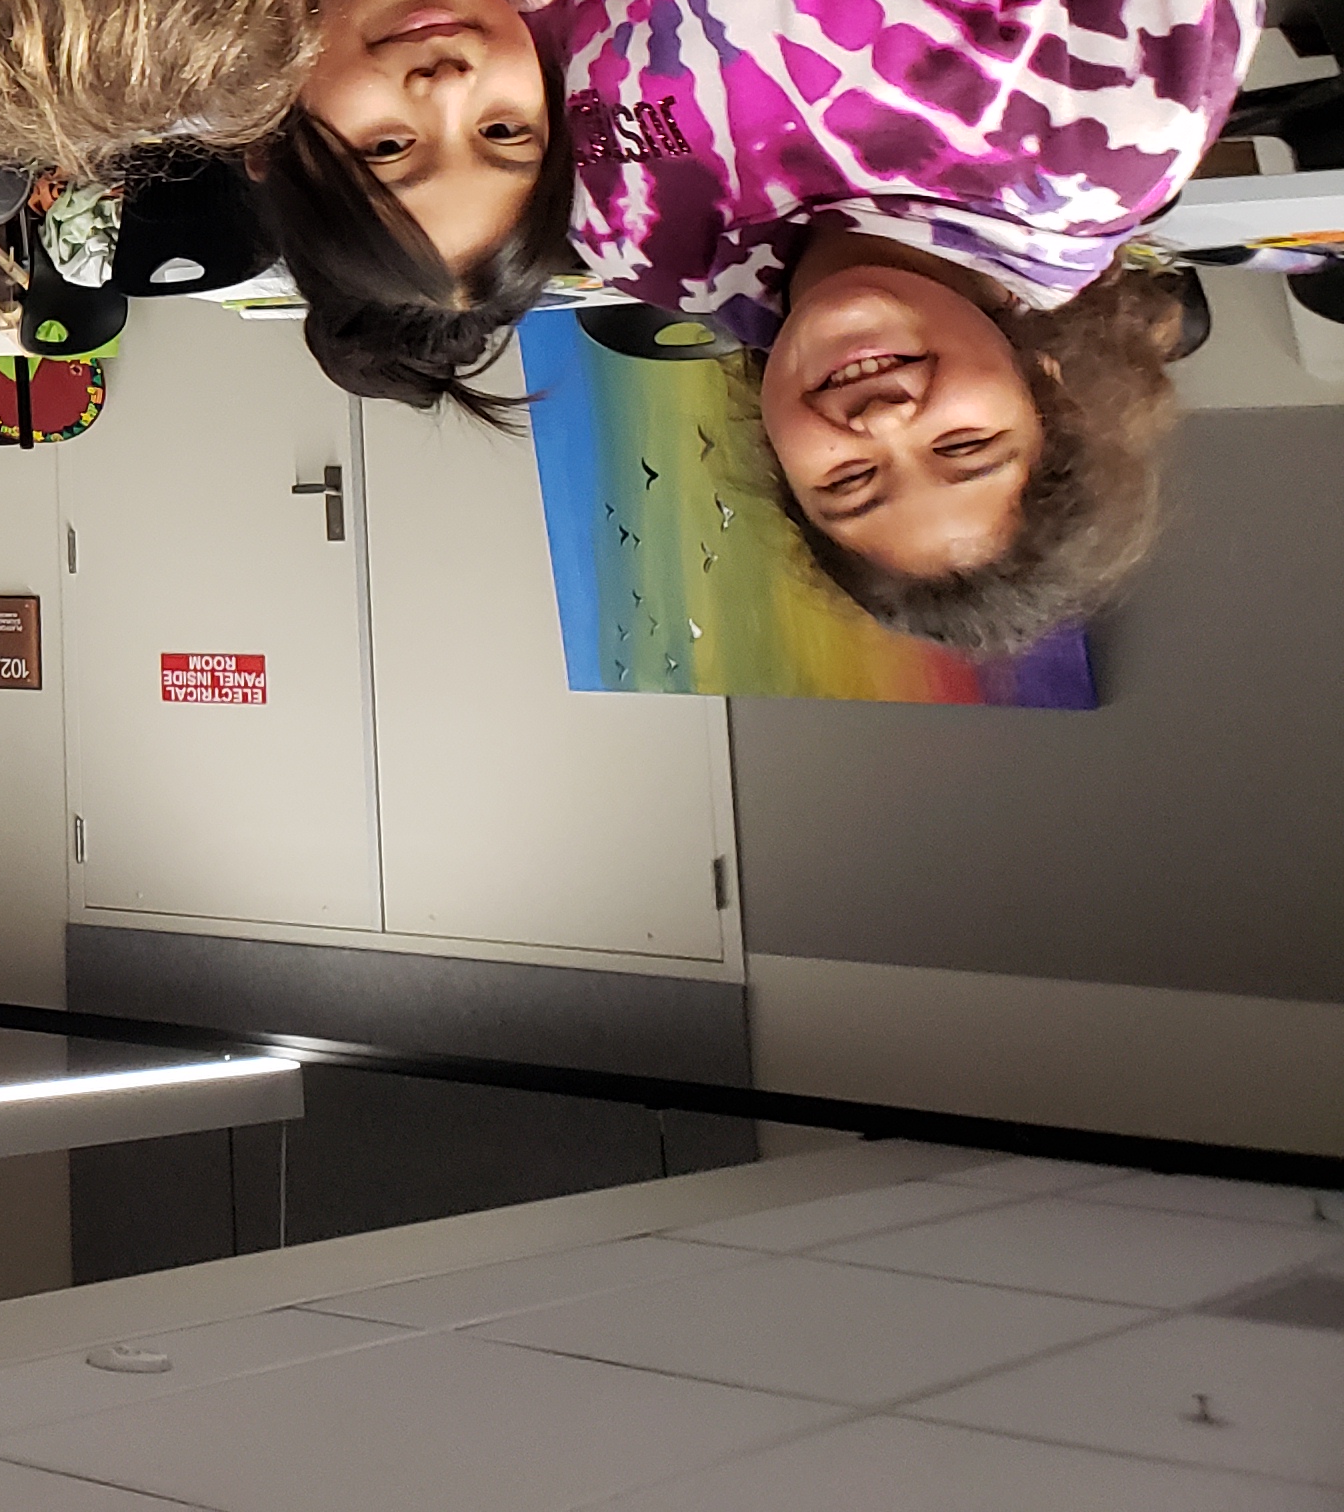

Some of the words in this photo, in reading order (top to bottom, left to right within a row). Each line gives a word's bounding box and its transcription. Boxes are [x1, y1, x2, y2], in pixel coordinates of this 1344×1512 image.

[189, 655, 236, 671] ROOM
[162, 670, 211, 686] INSIDE
[214, 671, 265, 687] PANEL
[166, 686, 263, 703] ELECTRICAL
